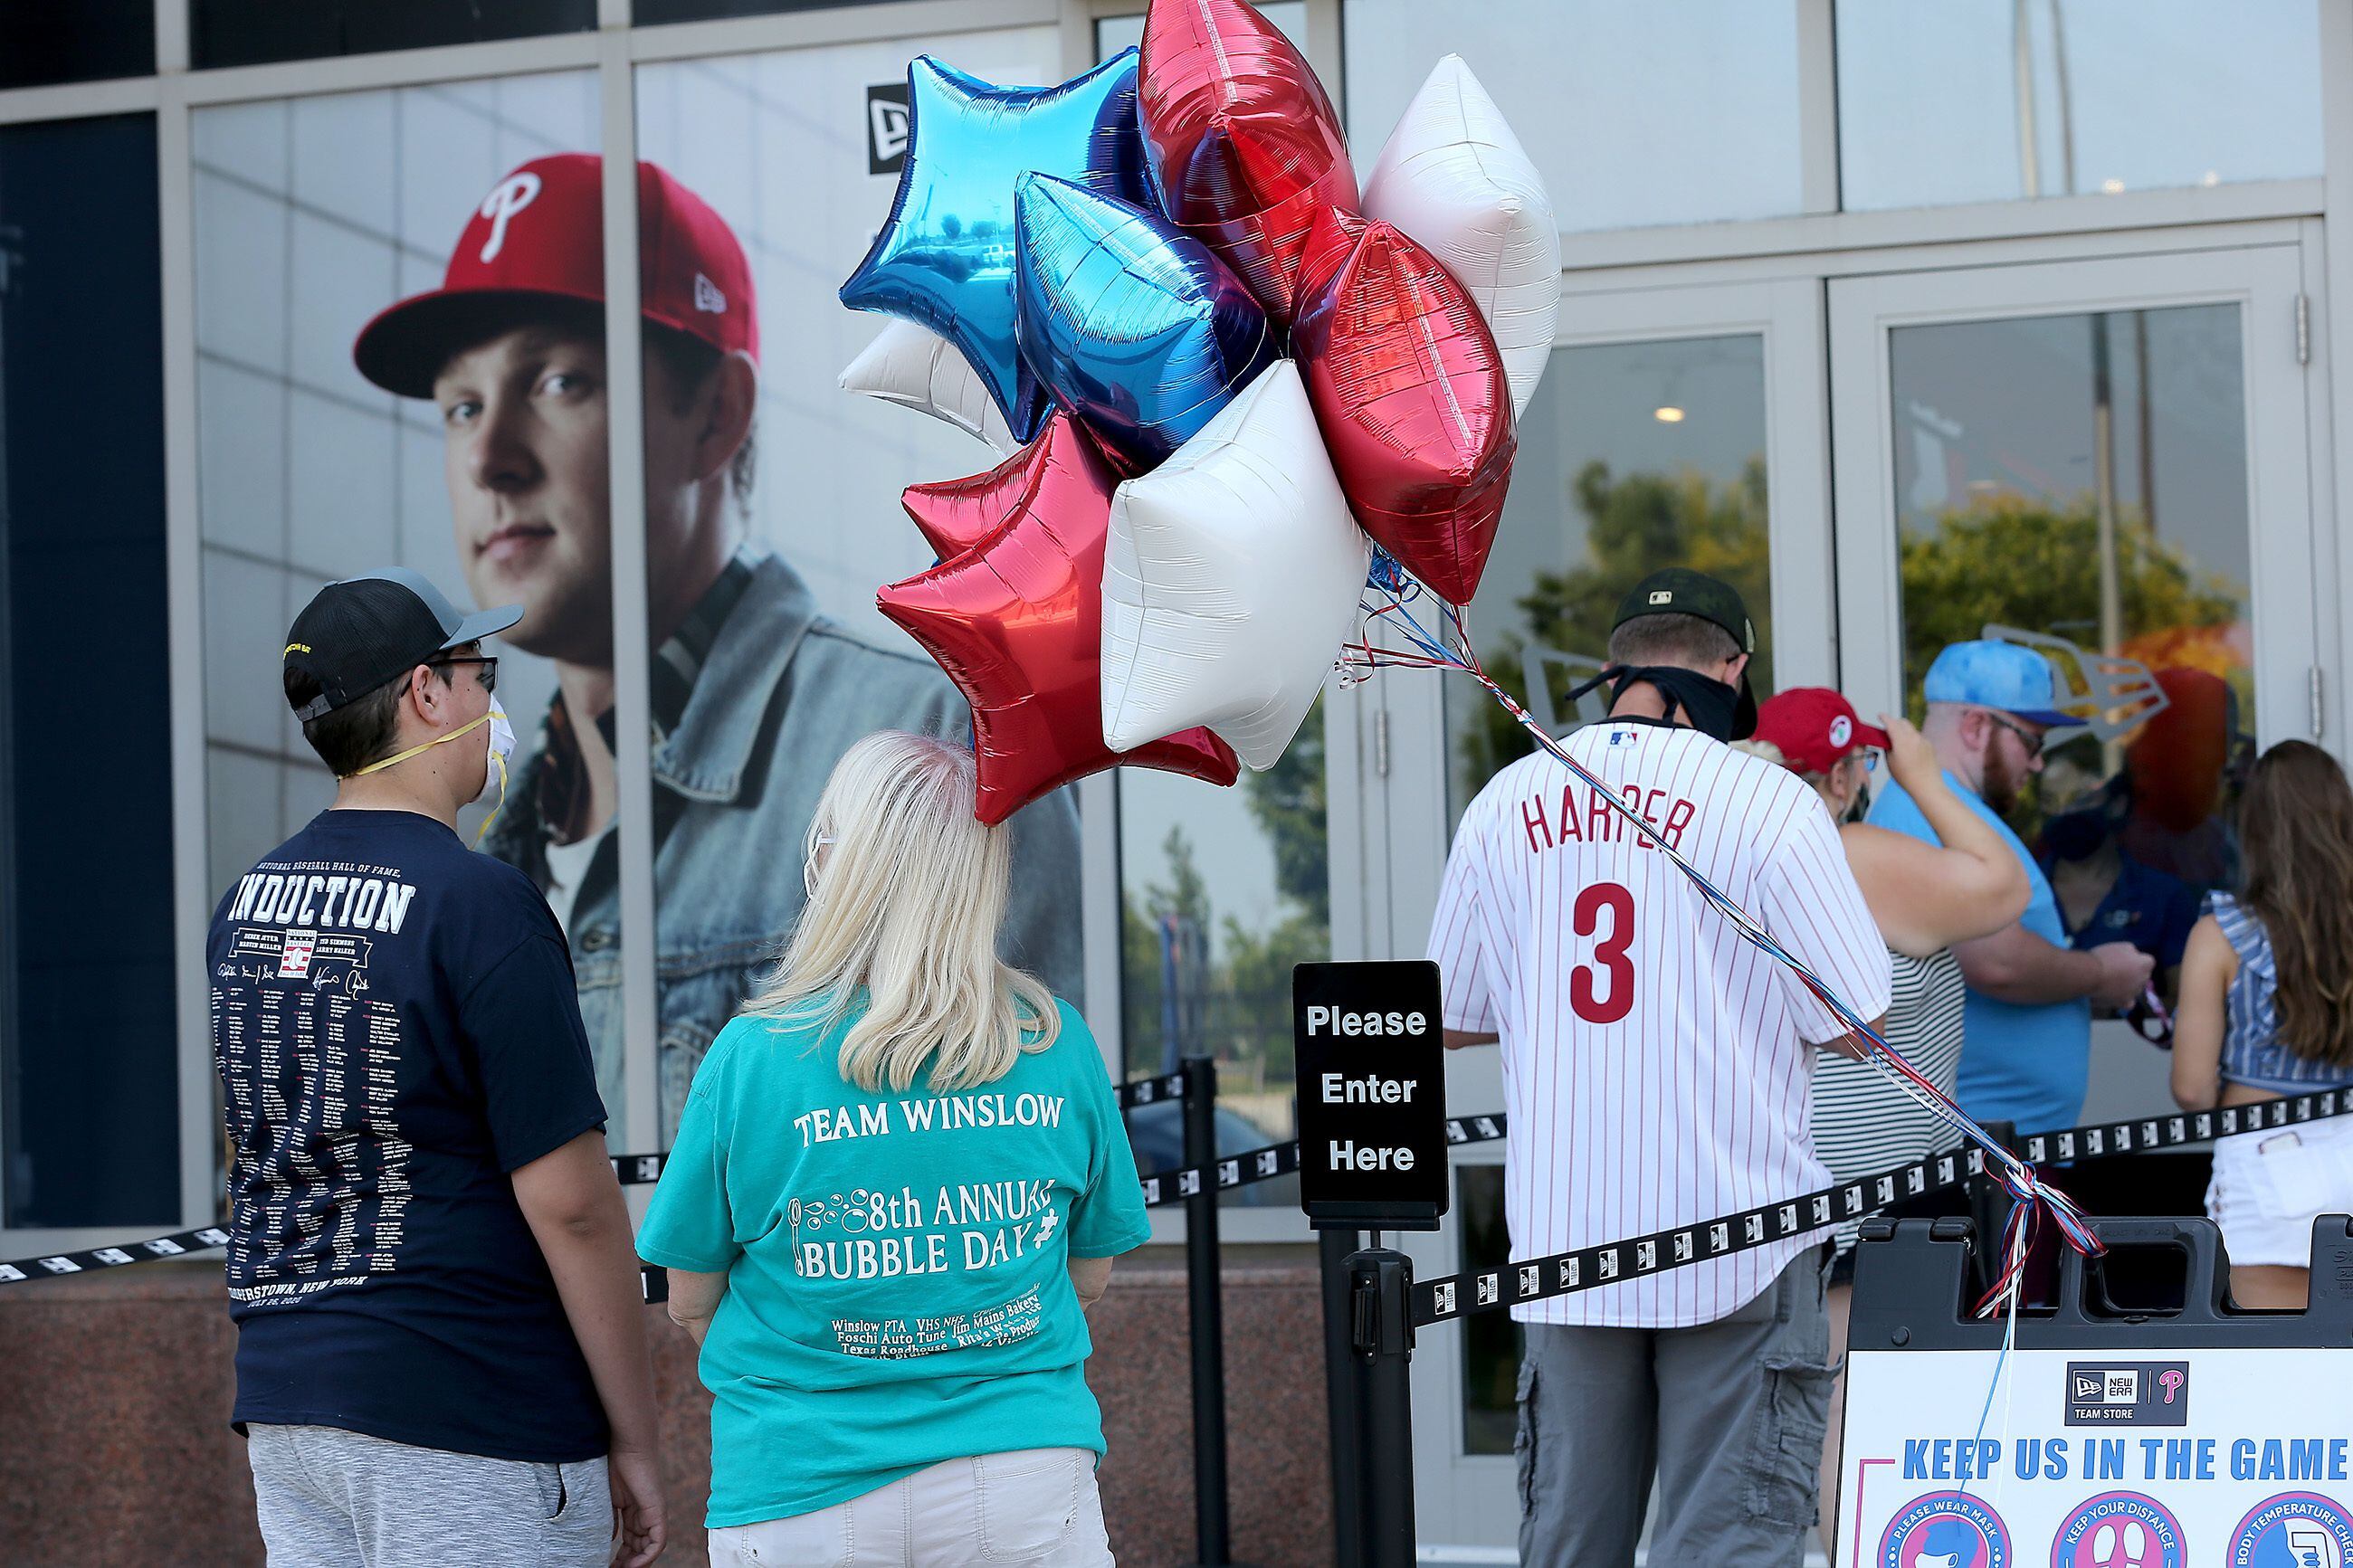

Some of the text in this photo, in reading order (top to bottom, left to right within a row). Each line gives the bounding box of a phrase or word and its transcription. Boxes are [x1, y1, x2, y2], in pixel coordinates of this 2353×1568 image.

[1521, 784, 1696, 854] HARPER
[292, 861, 330, 870] BASEBALL
[331, 862, 355, 871] HALL
[357, 864, 371, 872] OF
[227, 873, 416, 935] INDUCTION
[1570, 881, 1634, 1024] 3
[1307, 1005, 1427, 1036] Please
[1321, 1073, 1417, 1103] Enter
[793, 1092, 1065, 1148] TEAM WINSLOW
[1329, 1140, 1415, 1171] Here
[868, 1179, 1056, 1231] 8th ANNUAL
[802, 1221, 1033, 1279] BUBBLE DAY
[299, 1280, 330, 1295] NEW
[329, 1276, 368, 1288] YORK
[832, 1315, 966, 1333] Winslow PTA VHS NHS
[837, 1331, 878, 1345] Foschi
[881, 1332, 913, 1345] Auto
[916, 1330, 946, 1344] Tune
[952, 1322, 970, 1339] Jim
[973, 1310, 1005, 1329] Mains
[841, 1343, 876, 1354] Texas
[881, 1343, 948, 1355] Roadhouse
[957, 1329, 990, 1347] Rita's
[2110, 1377, 2133, 1387] NEW
[2110, 1387, 2133, 1396] ERA
[2074, 1409, 2134, 1419] TEAM STORE
[1902, 1438, 2348, 1480] KEEP US IN THE GAME
[1893, 1501, 1998, 1539] PLEASE WEAR MASK
[2065, 1501, 2176, 1551] KEEP YOUR DISTANCE
[2237, 1503, 2353, 1565] BODY TEMPERATURE CHECK
